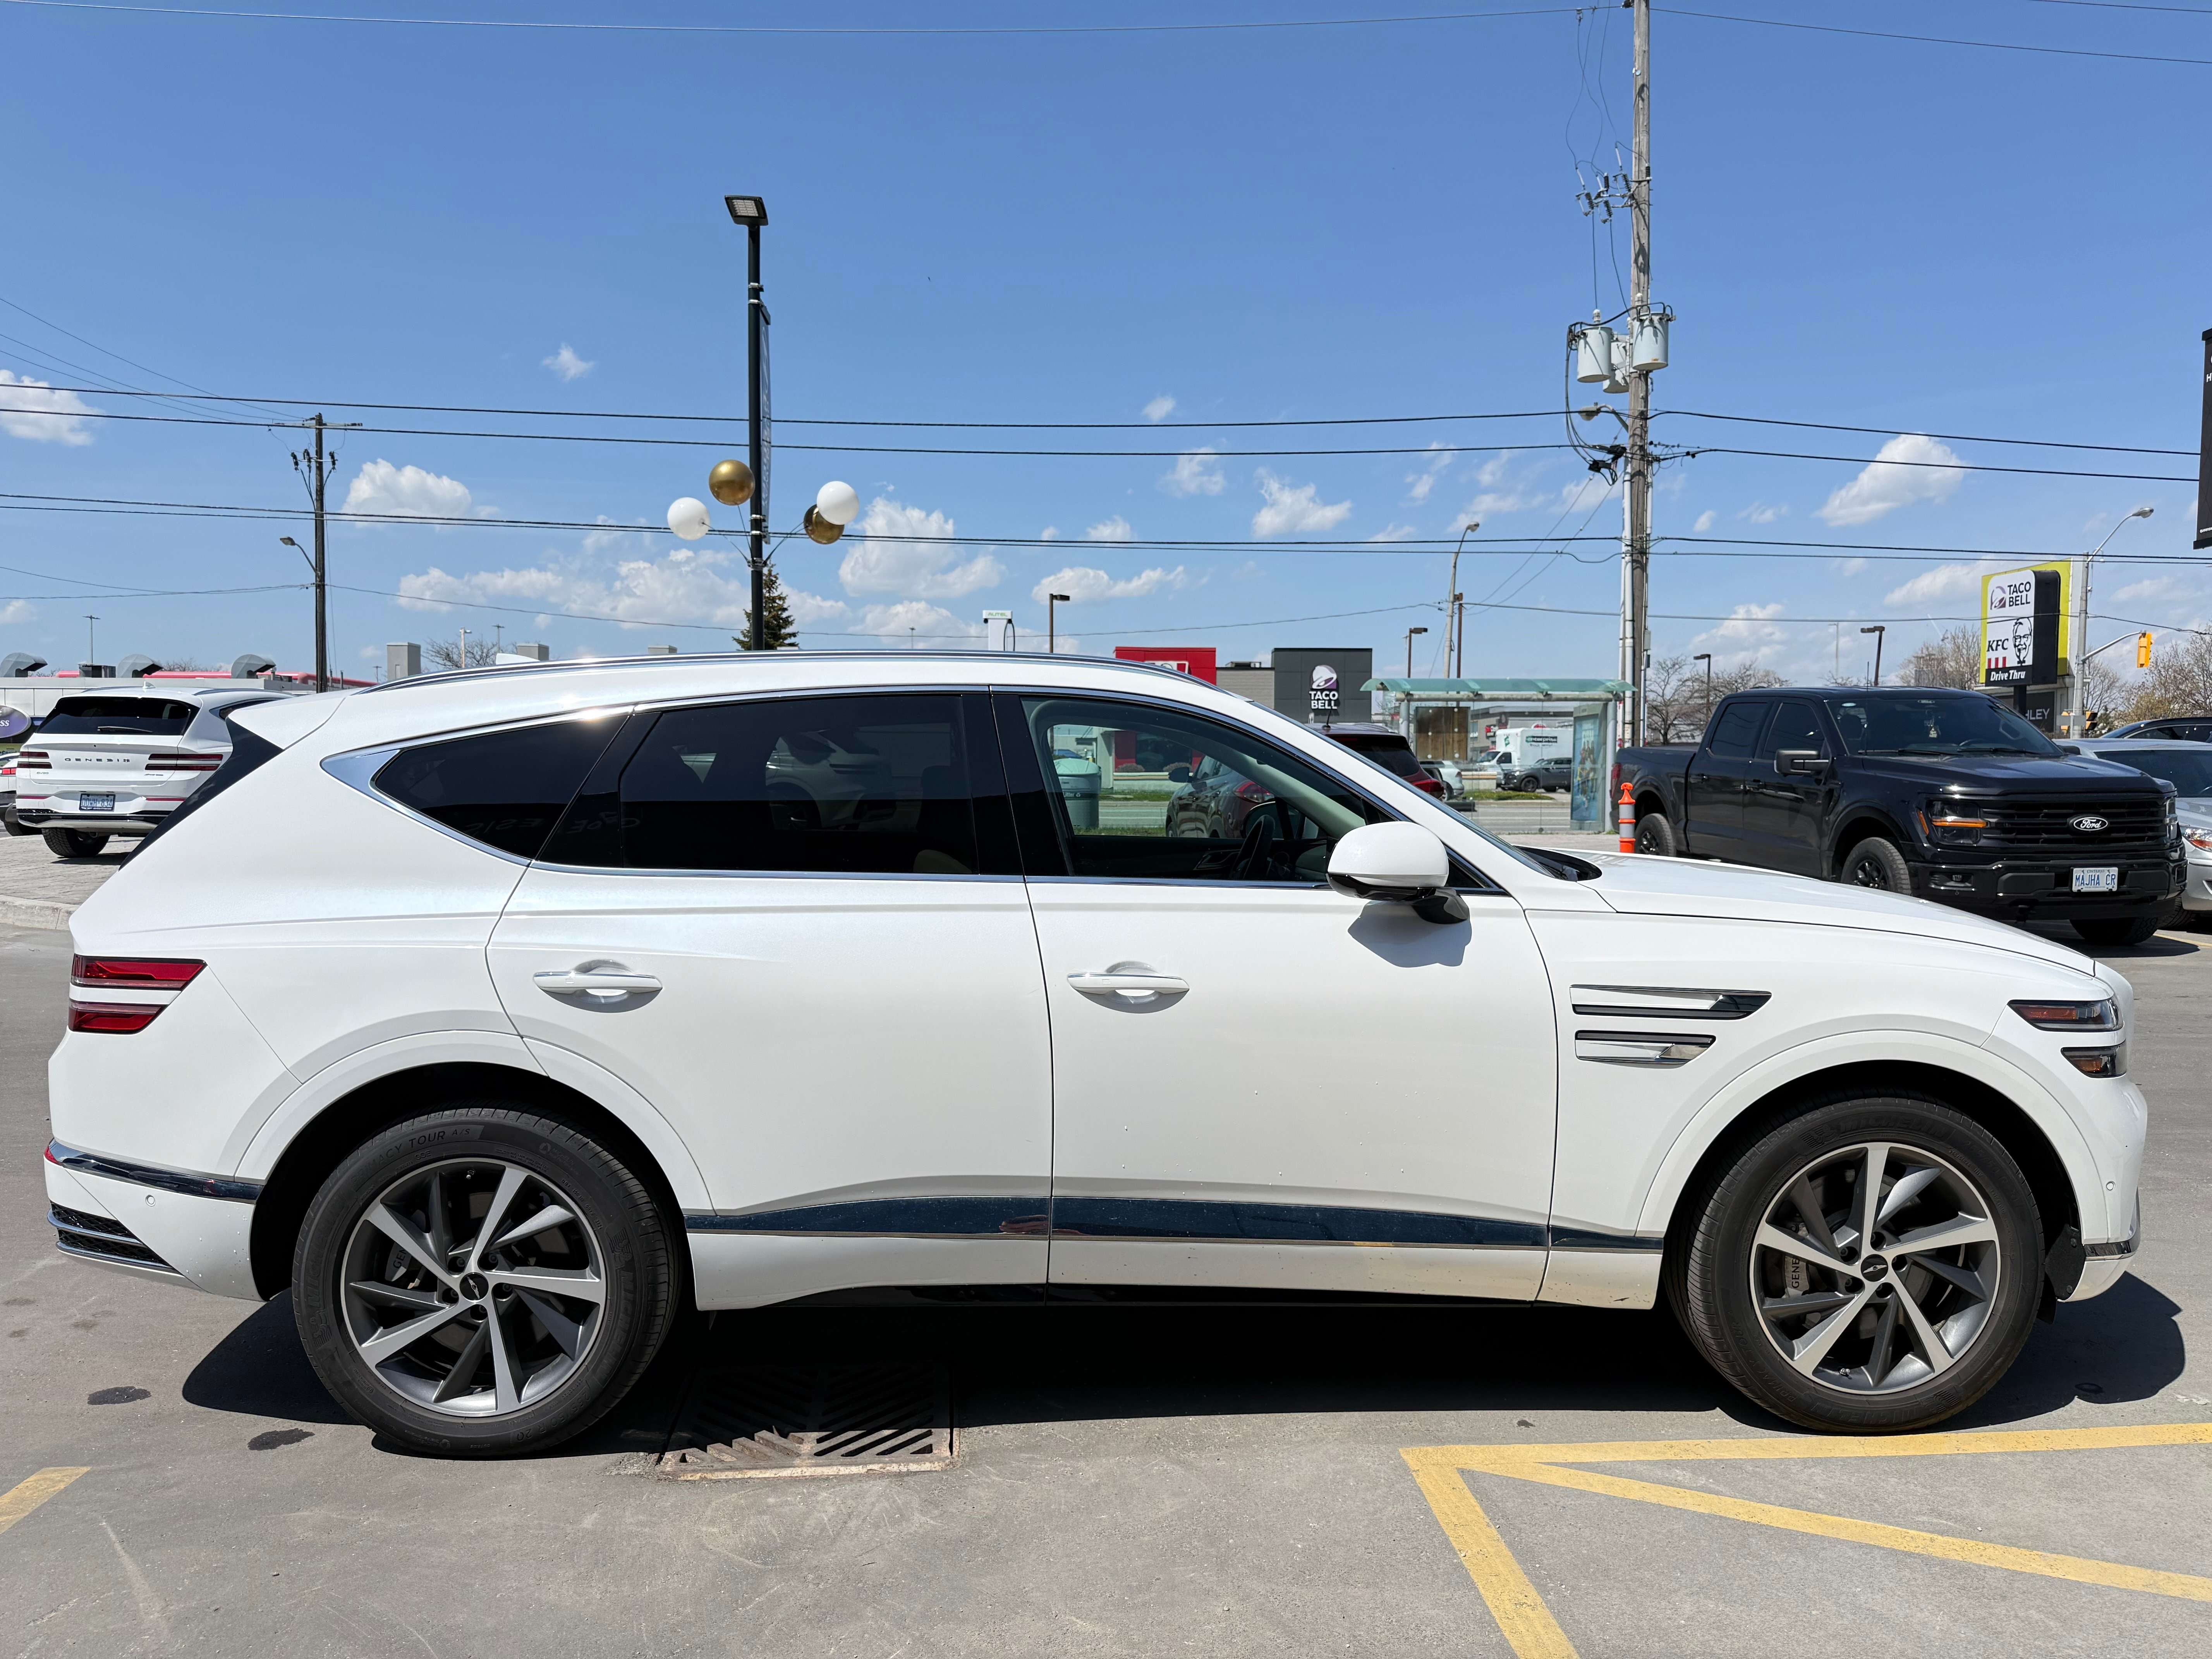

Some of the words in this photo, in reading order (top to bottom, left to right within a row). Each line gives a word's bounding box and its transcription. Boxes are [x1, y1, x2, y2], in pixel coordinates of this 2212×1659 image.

[2206, 372, 2212, 382] H
[2008, 581, 2031, 595] TACO
[2009, 594, 2030, 607] BELL
[1987, 639, 2009, 652] KFC
[1990, 671, 2008, 681] Drive
[2009, 670, 2026, 680] Thru
[1309, 691, 1338, 700] TACO
[1311, 700, 1338, 709] BELL
[2080, 819, 2101, 829] Ford
[2075, 874, 2100, 886] MAJHA
[2106, 874, 2116, 885] CR
[1840, 1115, 1949, 1138] MICHELIN
[409, 1130, 445, 1148] TOUR
[517, 1428, 533, 1441] 20
